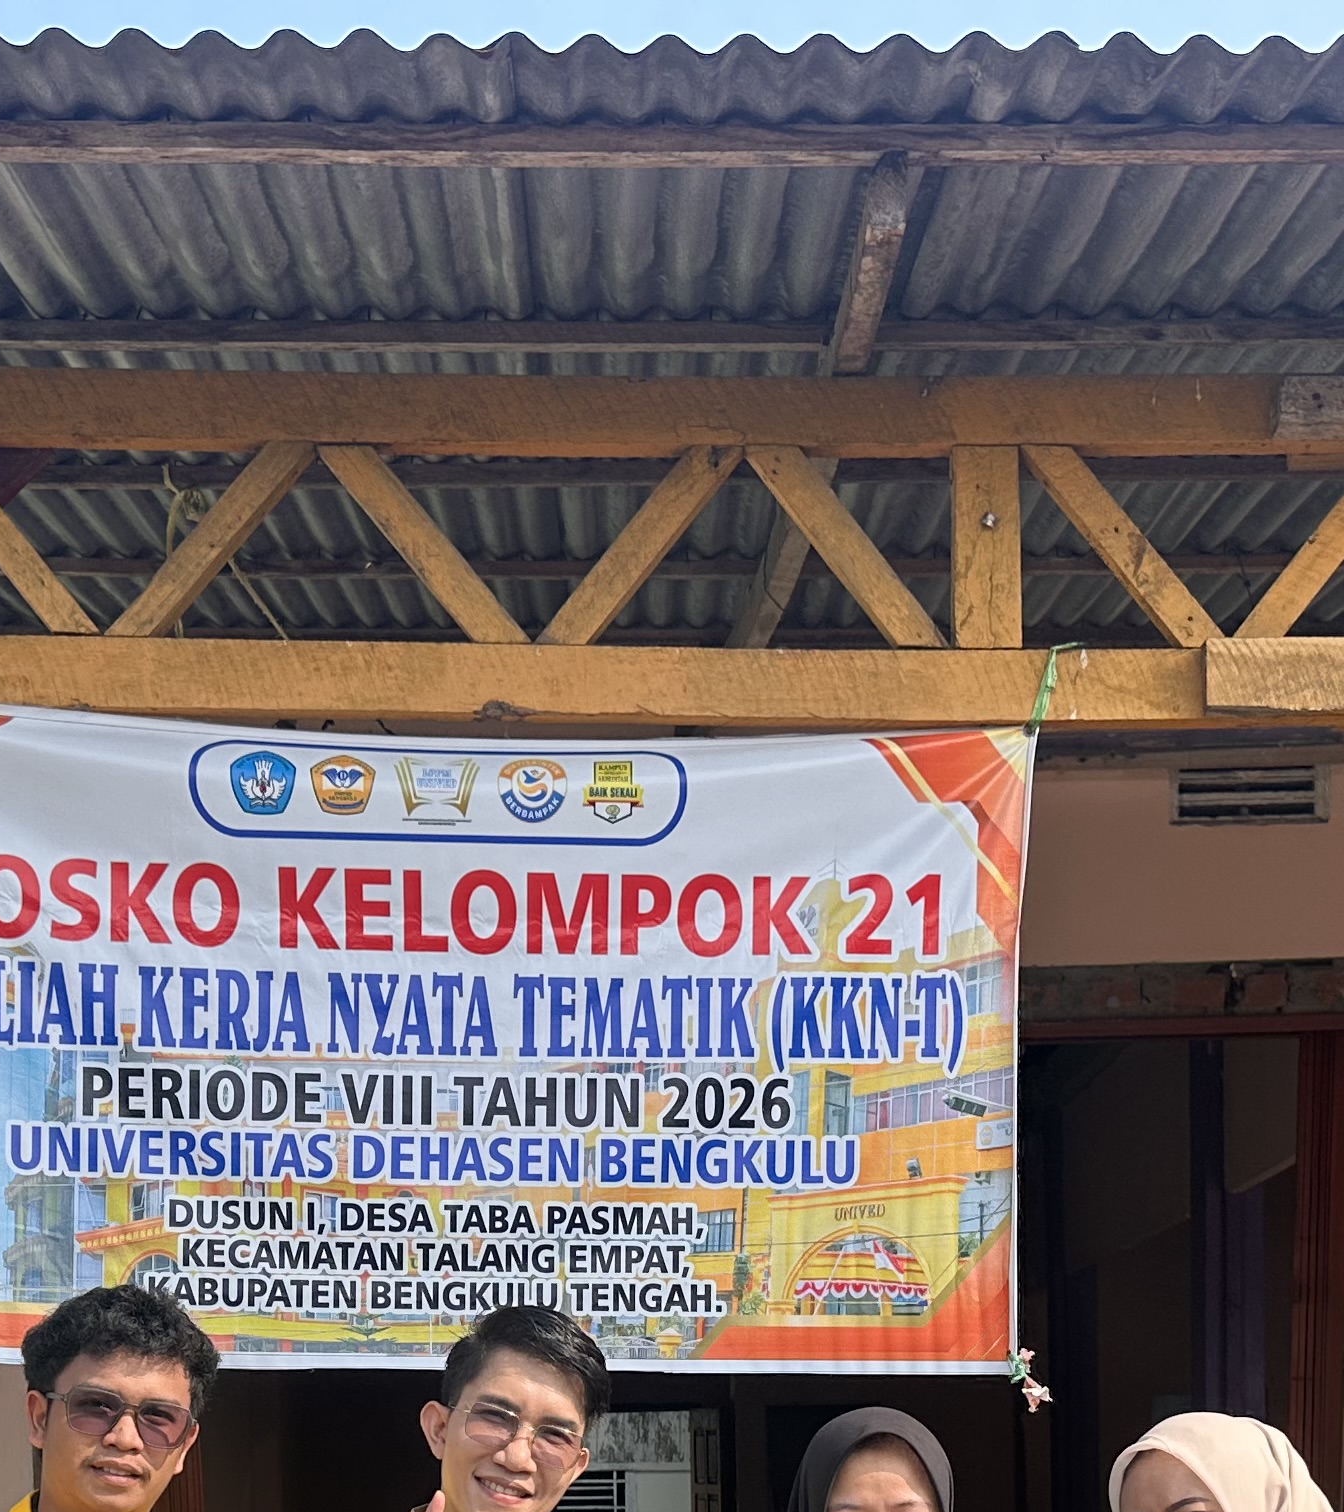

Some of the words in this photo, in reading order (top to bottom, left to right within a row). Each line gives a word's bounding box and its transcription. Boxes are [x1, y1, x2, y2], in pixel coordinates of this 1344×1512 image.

[505, 795, 560, 819] BERDAMPAK
[588, 786, 608, 798] BAIK
[610, 787, 638, 799] SEKALI
[278, 866, 814, 958] KELOMPOK
[845, 873, 942, 956] 21
[138, 965, 311, 1053] KERJA
[327, 971, 498, 1058] NYATA
[514, 973, 756, 1058] TEMATIK
[772, 973, 965, 1073] (KKN-T)
[81, 1066, 323, 1122] PERIODE
[341, 1073, 433, 1126] VIII
[453, 1076, 640, 1129] TAHUN
[662, 1077, 792, 1130] 2026
[11, 1124, 334, 1179] UNIVERSITAS
[353, 1134, 580, 1183] DEHASEN
[600, 1138, 856, 1185] BENGKULU
[169, 1199, 293, 1232] DUSUN
[340, 1202, 434, 1233] DESA
[444, 1204, 535, 1235] TABA
[547, 1205, 704, 1240] PASMAH,
[182, 1238, 404, 1272] KECAMATAN
[417, 1242, 555, 1275] TALANG
[570, 1244, 691, 1279] EMPAT,
[148, 1276, 357, 1309] KABUPATEN
[371, 1281, 558, 1312] BENGKULU
[571, 1283, 724, 1313] TENGAH.
